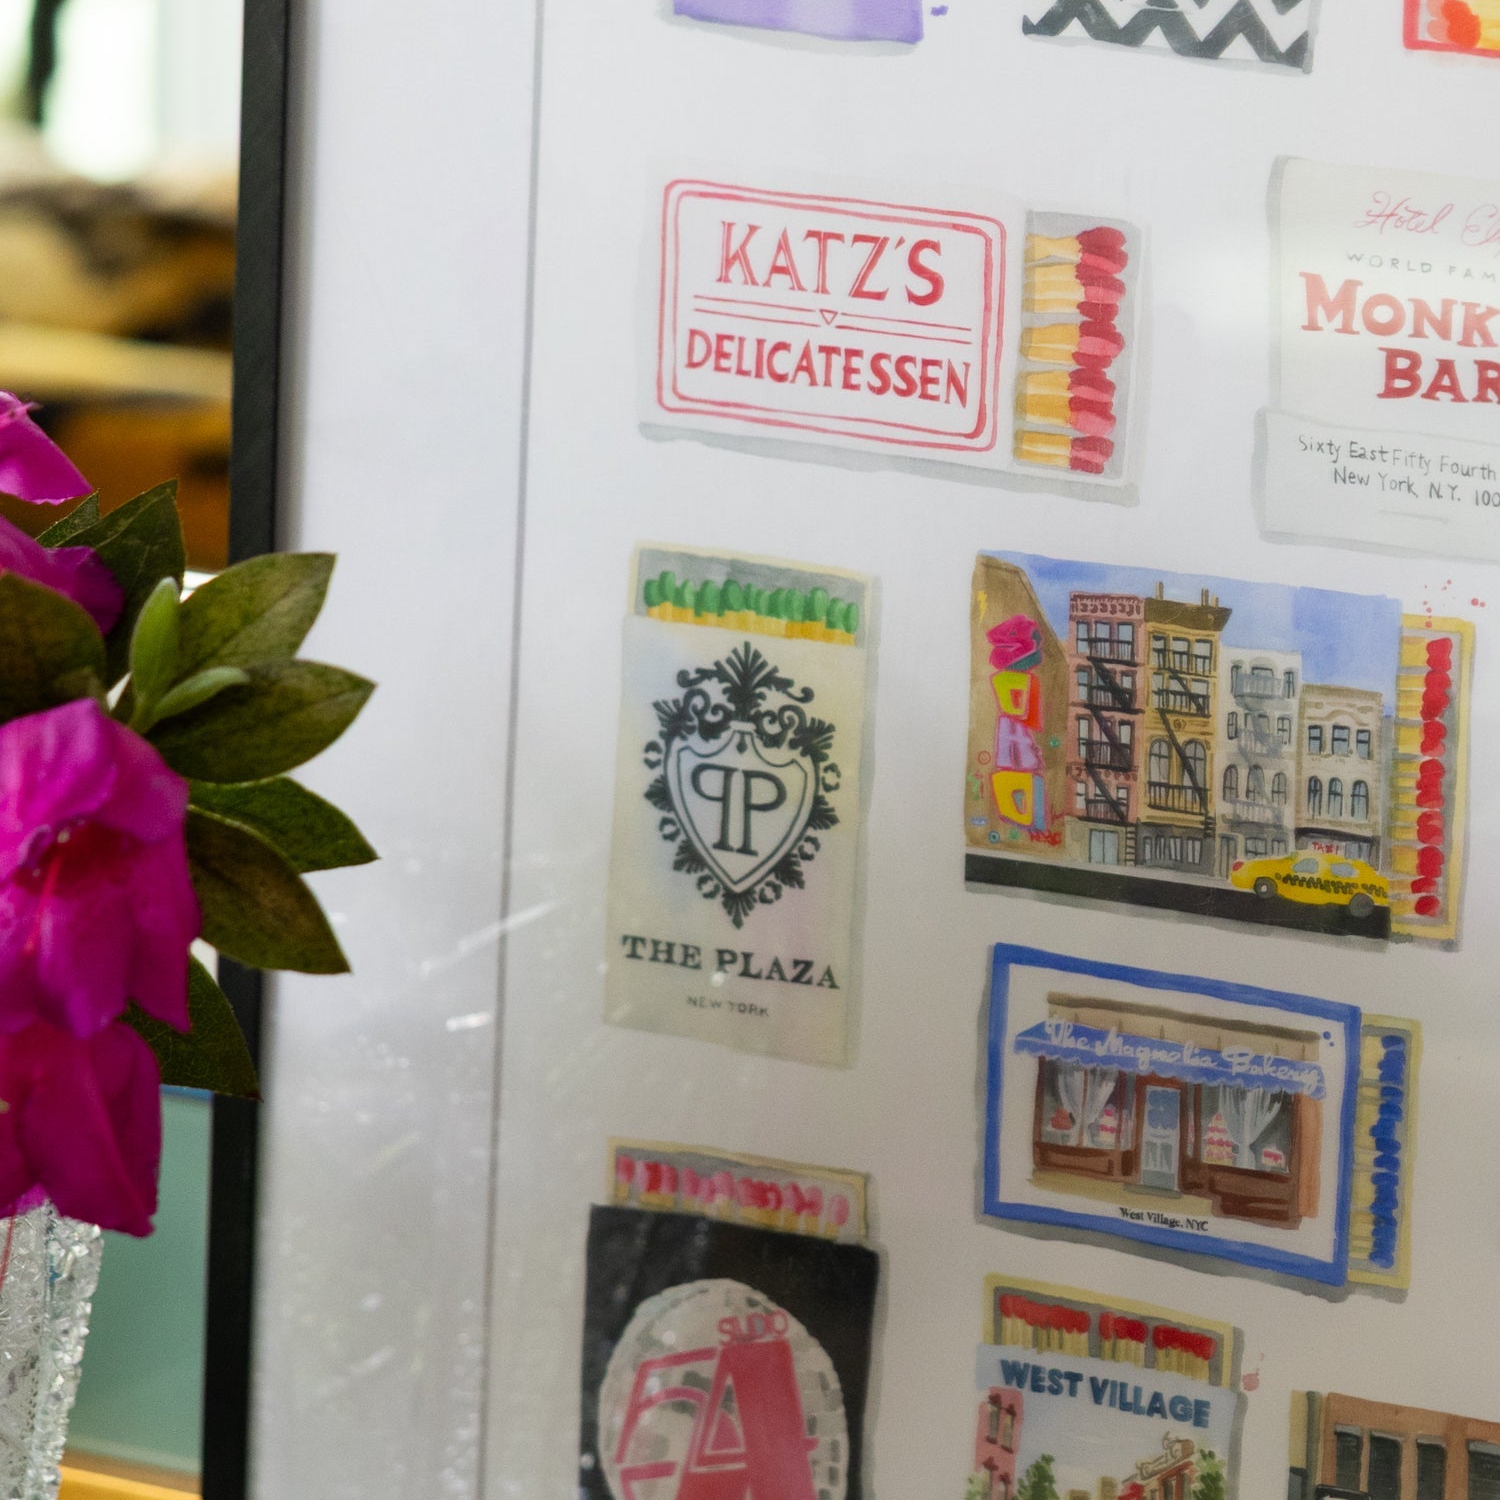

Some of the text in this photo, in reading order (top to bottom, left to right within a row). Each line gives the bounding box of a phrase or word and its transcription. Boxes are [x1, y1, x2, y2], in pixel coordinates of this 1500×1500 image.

[1354, 190, 1456, 235] Hotel
[715, 219, 946, 307] KATZ'S
[1346, 251, 1433, 275] WORLD
[685, 328, 970, 410] DELICATESSEN
[1298, 434, 1341, 464] Sixty
[1349, 440, 1389, 464] East
[1392, 449, 1431, 477] Fifty
[1439, 454, 1497, 482] Fourth
[1333, 465, 1370, 487] New
[1377, 471, 1420, 499] York,
[1428, 481, 1462, 503] N.Y.
[621, 934, 841, 991] THE PLAZA
[687, 994, 771, 1019] NEW YORK
[1044, 1014, 1090, 1050] The
[1095, 1025, 1218, 1071] Magnolia
[1119, 1206, 1144, 1221] West
[1186, 1218, 1209, 1232] NYC
[998, 1357, 1212, 1429] WEST VILLAGE
